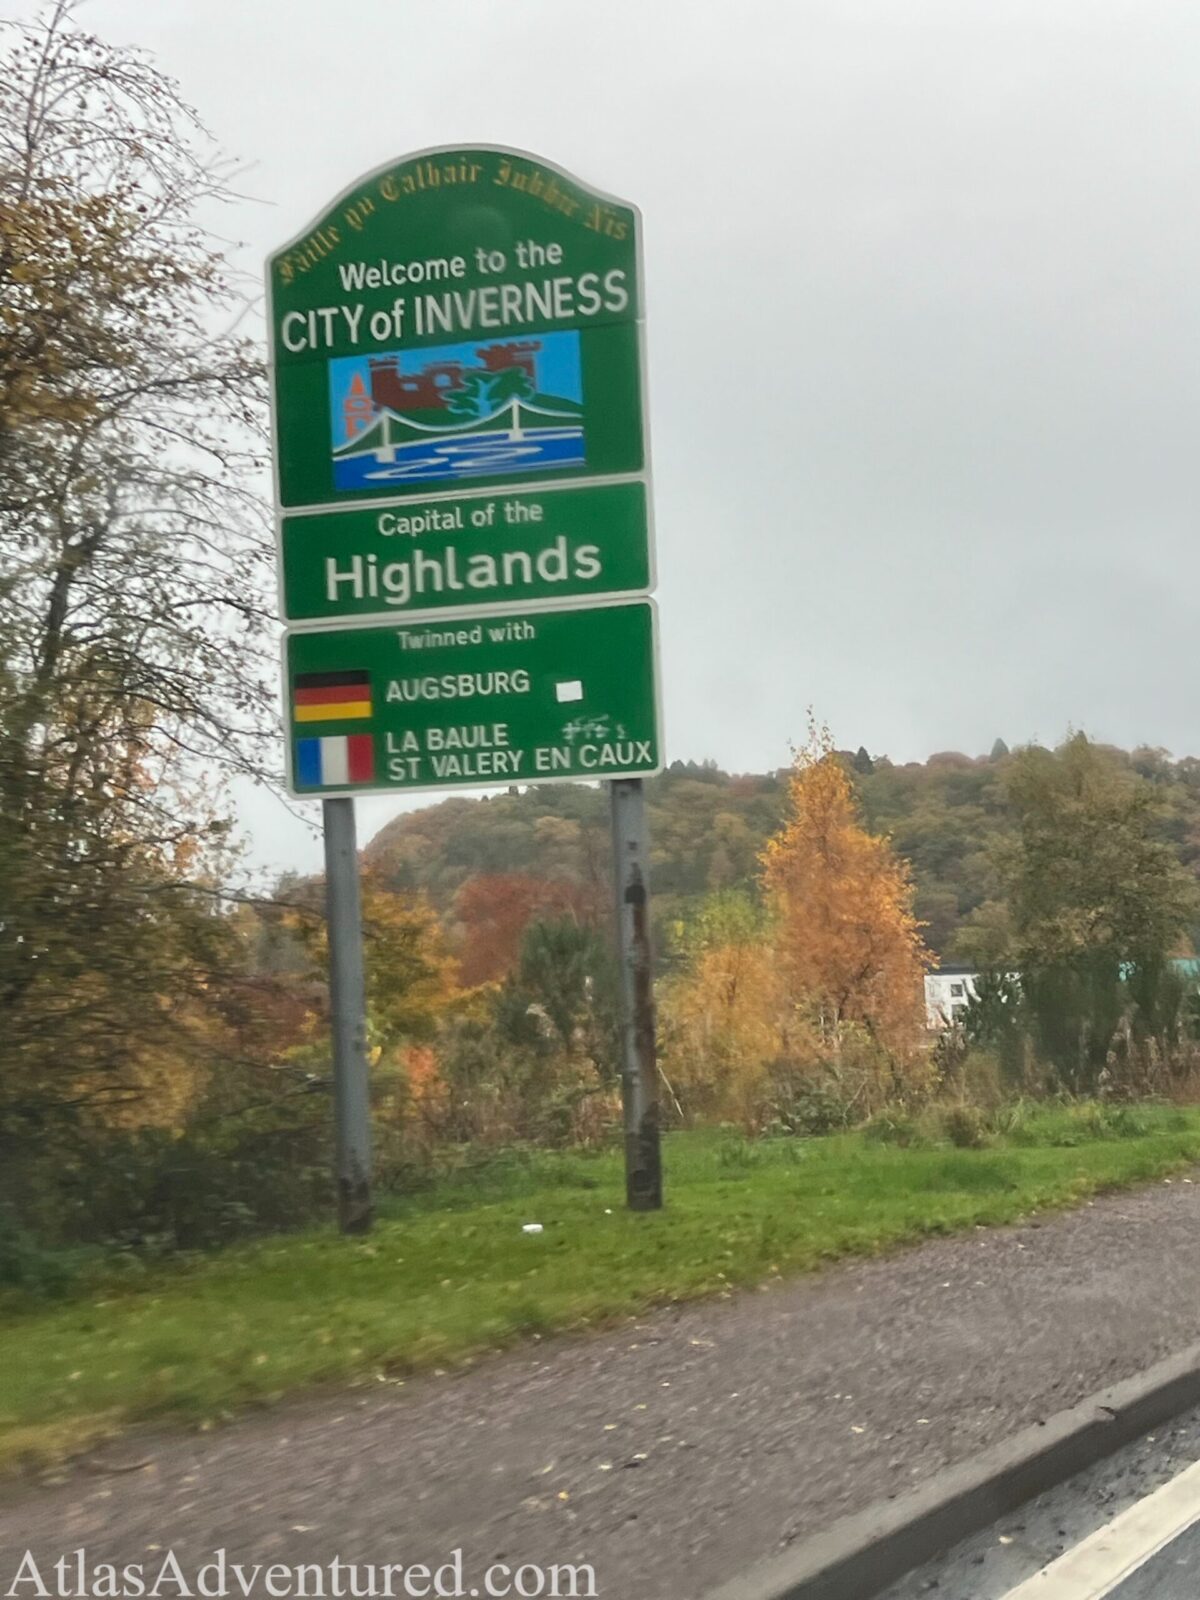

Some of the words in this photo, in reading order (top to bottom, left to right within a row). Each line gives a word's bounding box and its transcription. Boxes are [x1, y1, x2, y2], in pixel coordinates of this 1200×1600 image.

[339, 257, 465, 292] Welcome
[477, 248, 507, 274] to
[515, 239, 563, 268] the
[282, 305, 365, 352] CITY
[370, 304, 405, 341] of
[415, 269, 629, 336] INVERNESS
[378, 506, 462, 537] Capital
[471, 504, 496, 527] of
[504, 501, 543, 524] the
[325, 535, 601, 605] Highlands
[398, 624, 482, 650] Twinned
[489, 620, 535, 643] with
[385, 669, 531, 703] AUGSBURG
[386, 731, 419, 753] LA
[427, 723, 509, 751] BAULE
[390, 757, 422, 782] ST
[431, 750, 523, 778] VALERY
[535, 746, 571, 769] EN
[579, 740, 653, 767] CAUX
